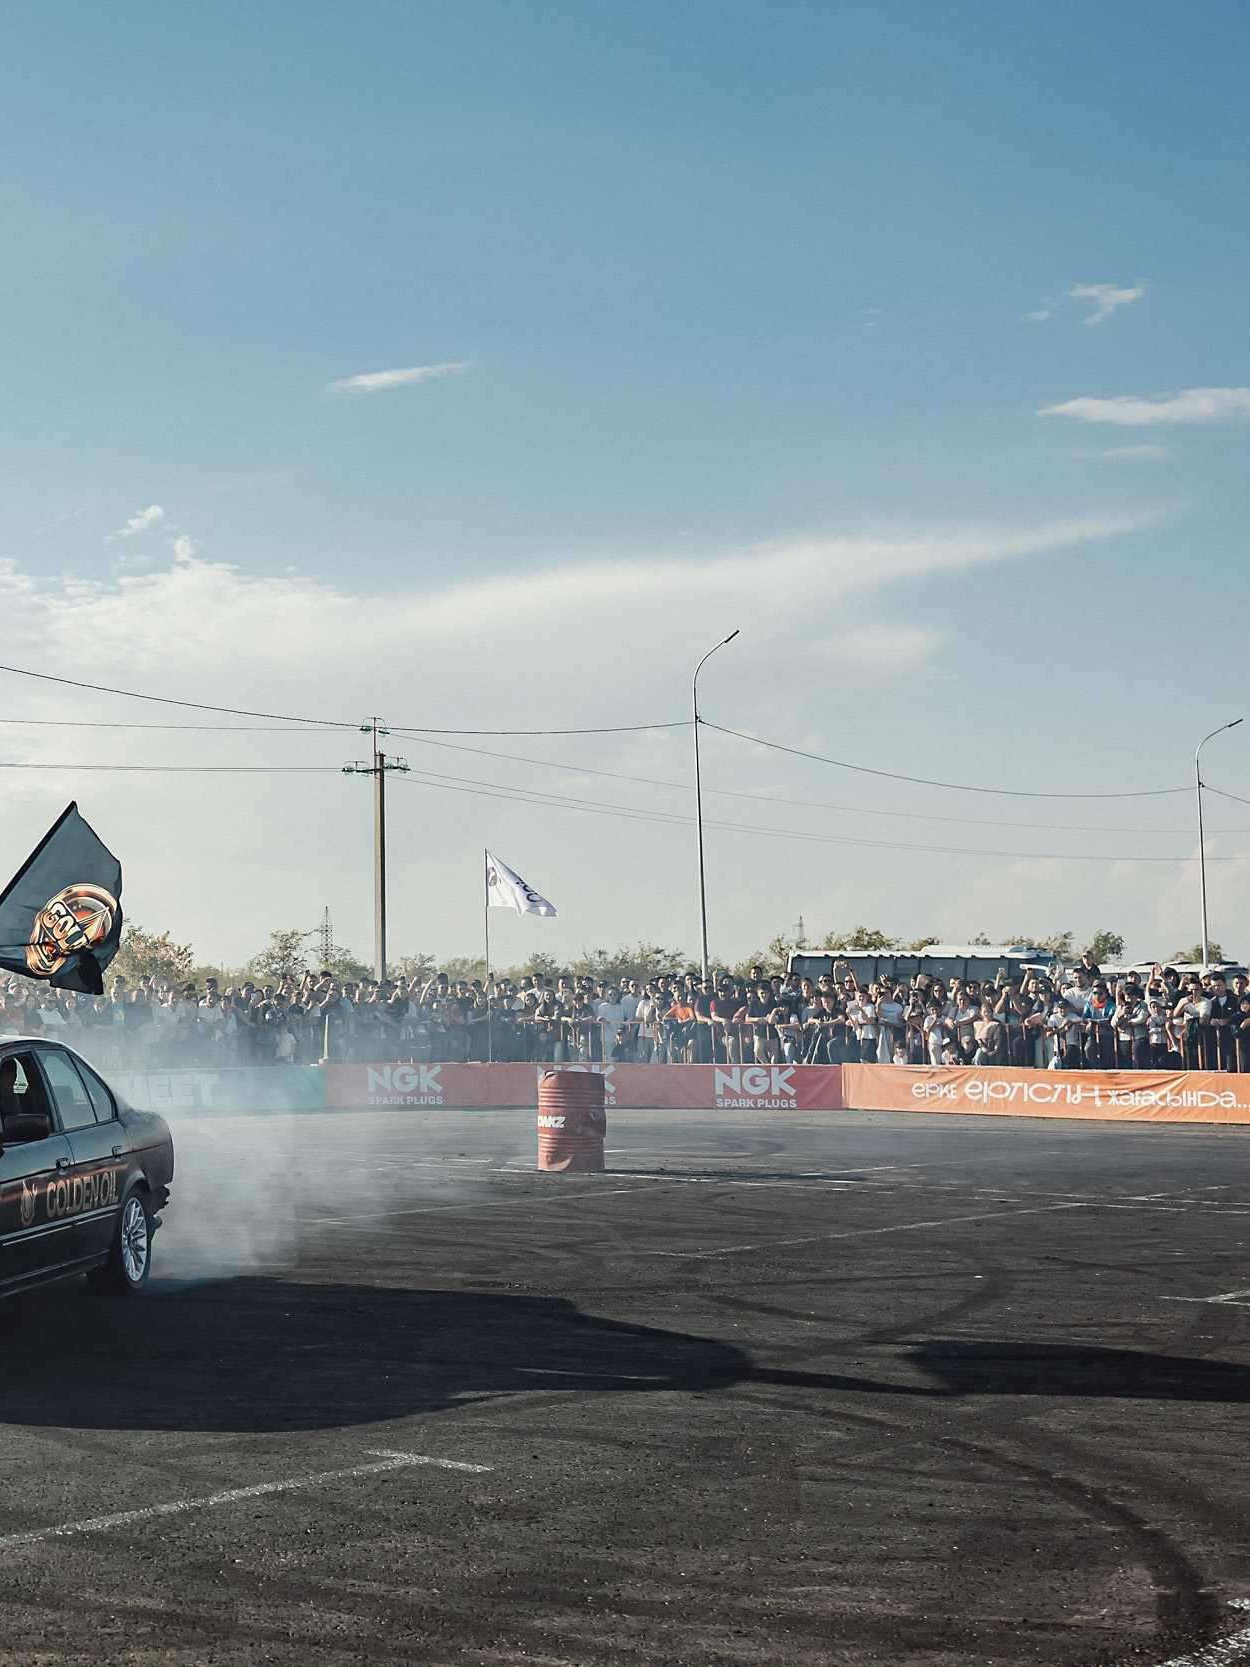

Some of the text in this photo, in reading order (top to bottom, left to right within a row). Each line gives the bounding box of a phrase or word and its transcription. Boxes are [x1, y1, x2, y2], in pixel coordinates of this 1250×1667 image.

[367, 1064, 443, 1093] NGK
[715, 1066, 797, 1097] NGK
[369, 1096, 443, 1105] SPARK PLUGS
[716, 1099, 797, 1108] SPARK PLUGS
[100, 1170, 119, 1206] OIL
